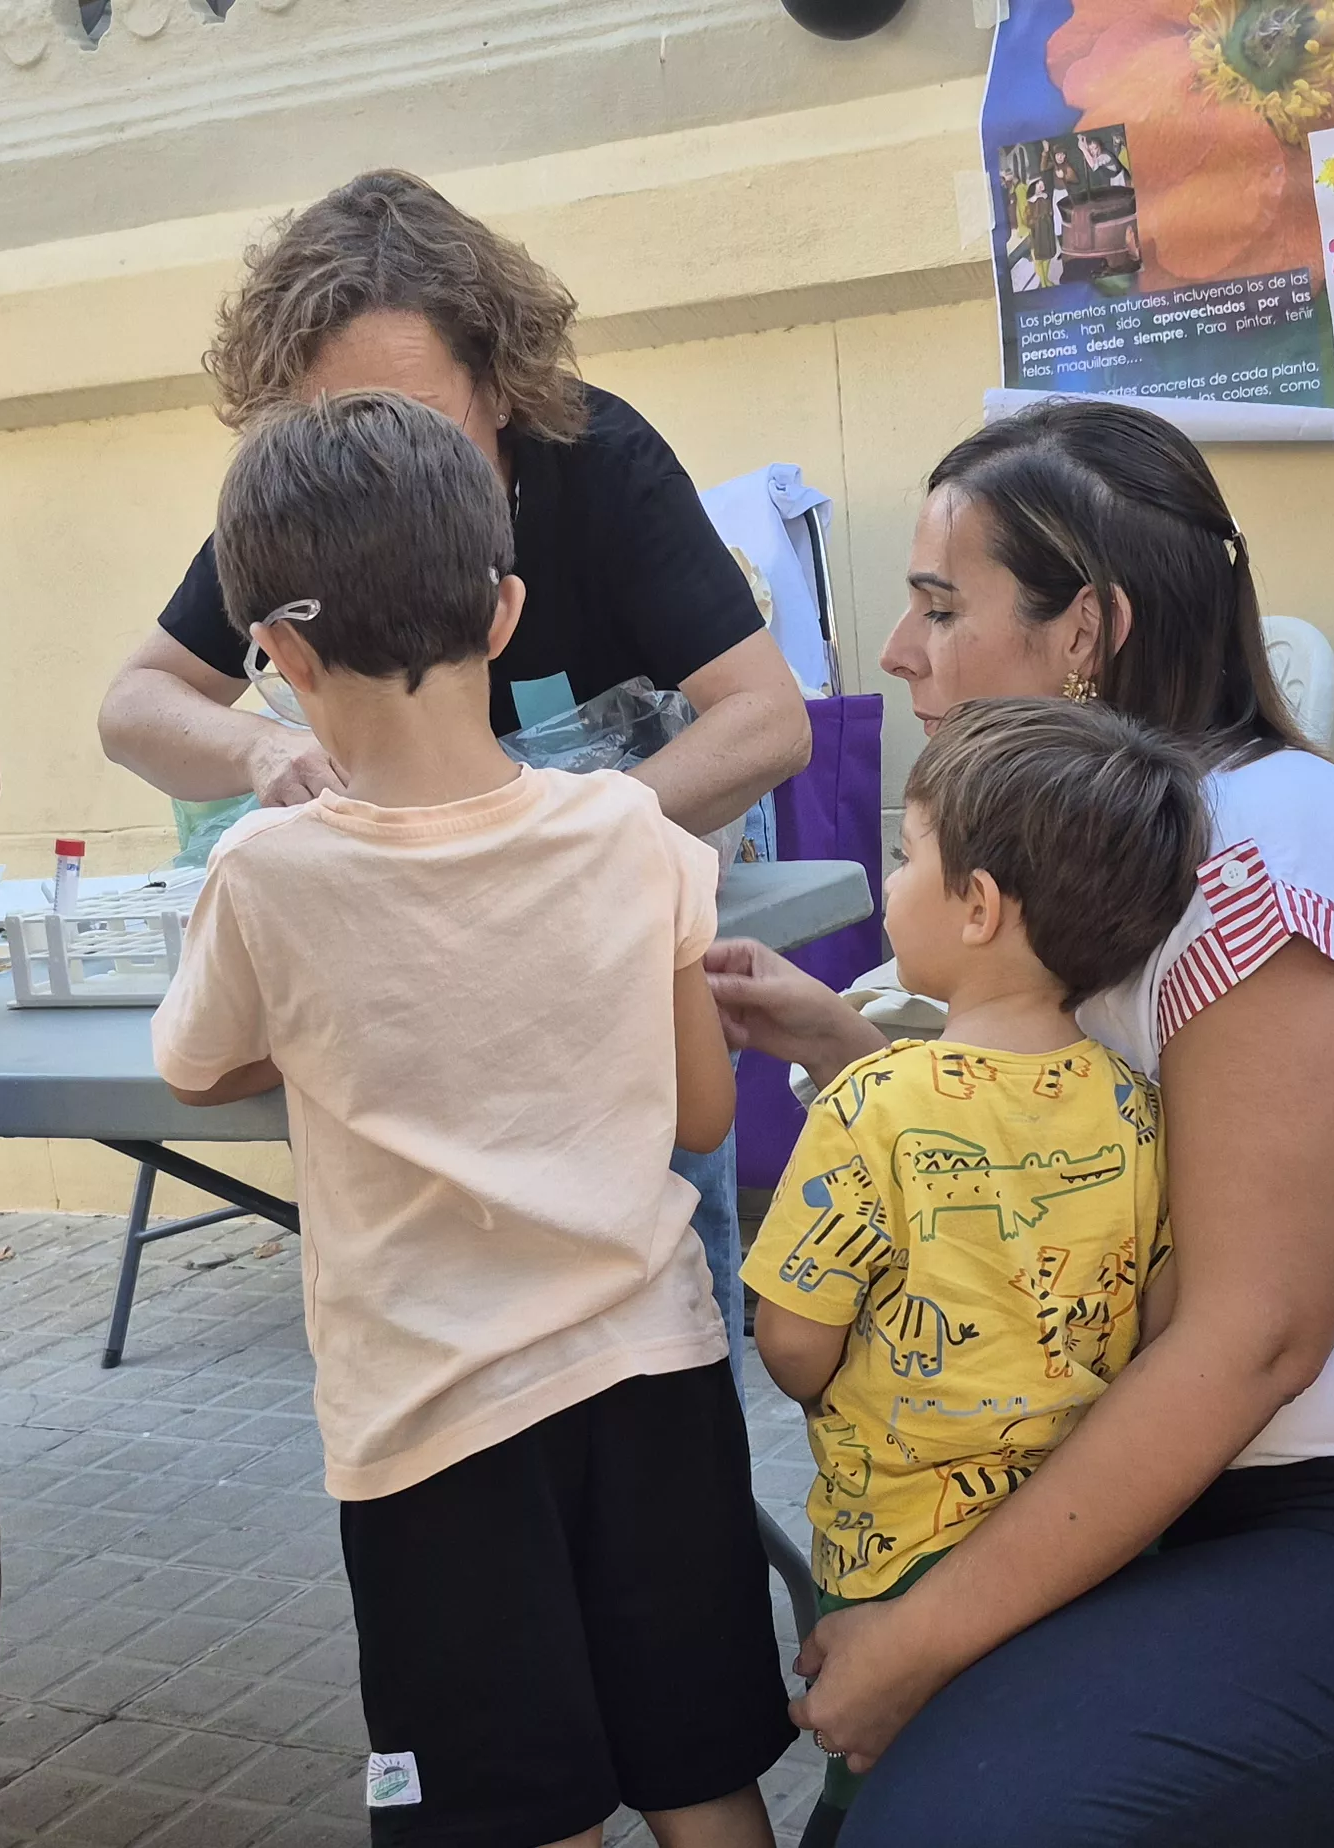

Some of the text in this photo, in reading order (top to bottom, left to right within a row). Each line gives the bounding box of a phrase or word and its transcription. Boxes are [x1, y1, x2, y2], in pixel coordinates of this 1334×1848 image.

[1020, 273, 1309, 328] Los pigmentos naturales, incluyendo los de las
[1021, 291, 1311, 347] plantas, han sido aprovechados por las
[1022, 306, 1314, 364] personas desde siempre. Para pintar, teñir
[1022, 365, 1054, 378] telas,
[1140, 377, 1206, 395] concretas
[1209, 373, 1228, 385] de
[1231, 367, 1268, 382] cada
[1272, 360, 1319, 379] planta,
[1222, 385, 1272, 401] colores,
[1279, 379, 1321, 393] como
